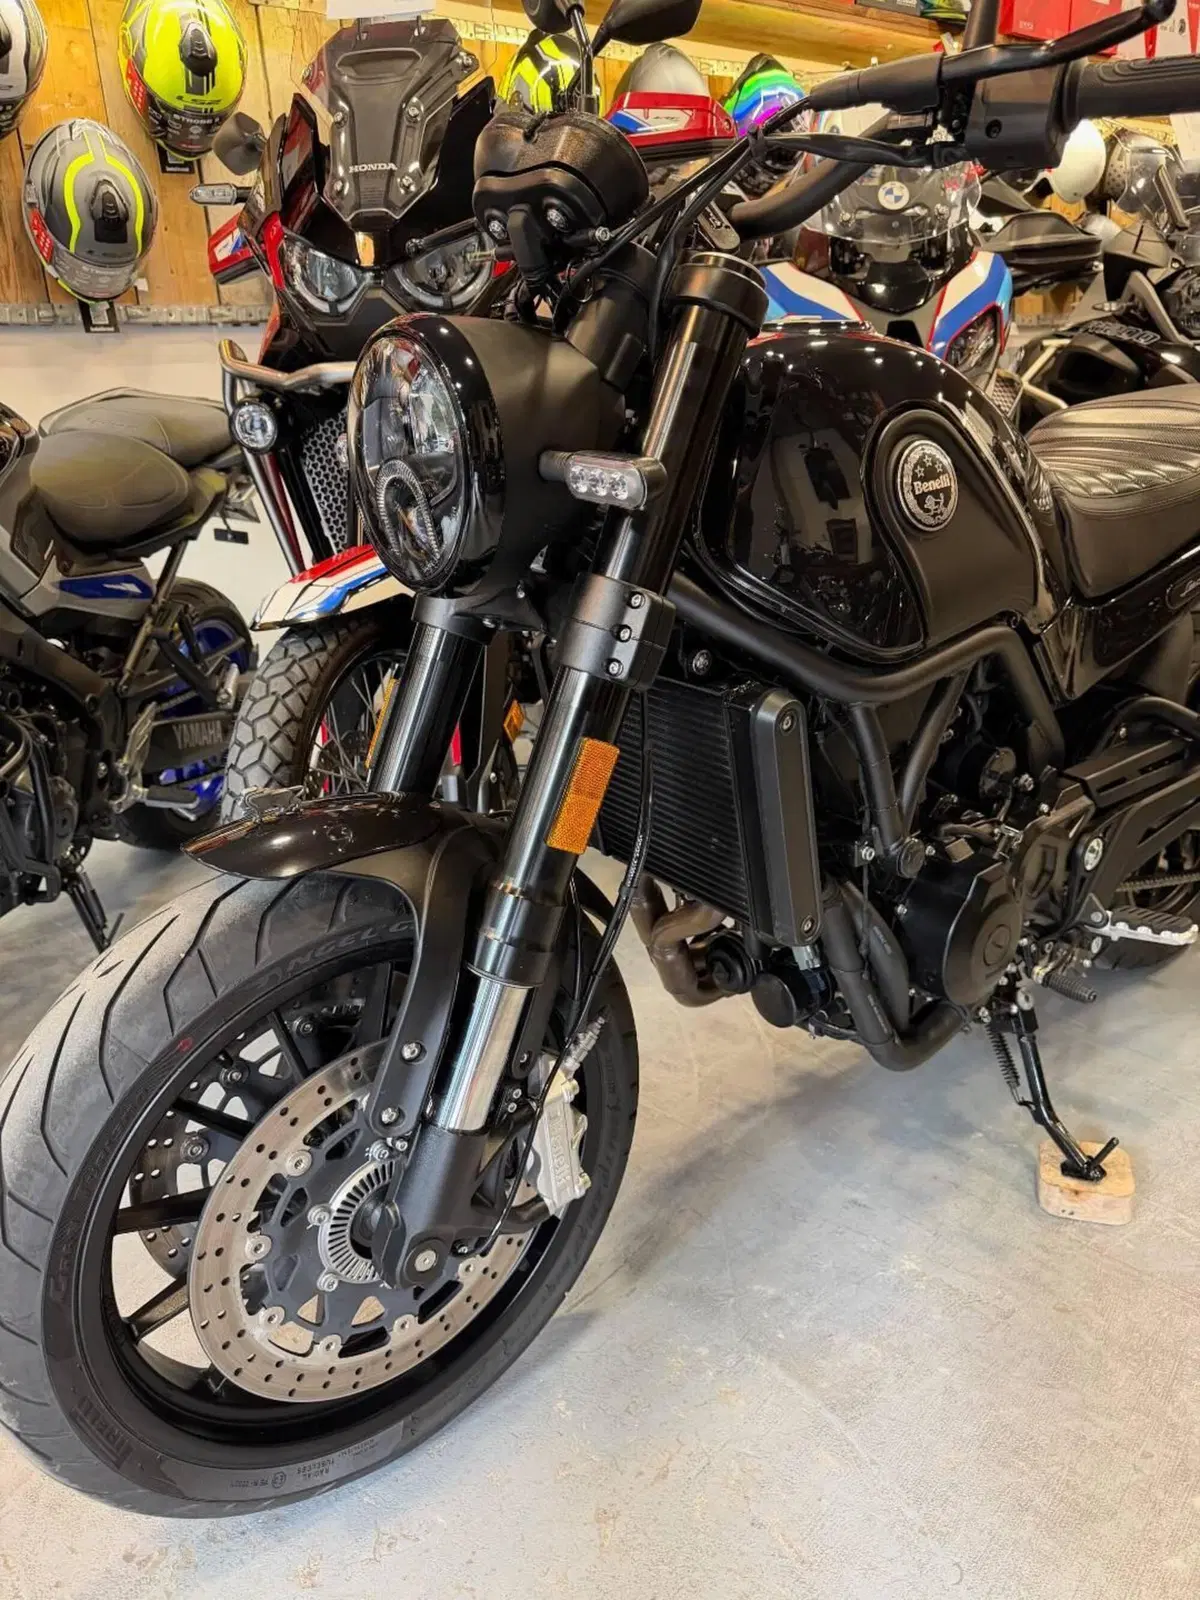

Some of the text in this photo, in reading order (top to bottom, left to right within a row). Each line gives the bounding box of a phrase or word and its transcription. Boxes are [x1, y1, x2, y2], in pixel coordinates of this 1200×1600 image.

[348, 163, 397, 174] HONDA
[913, 473, 951, 495] Benelli
[172, 719, 223, 749] YAMAHA
